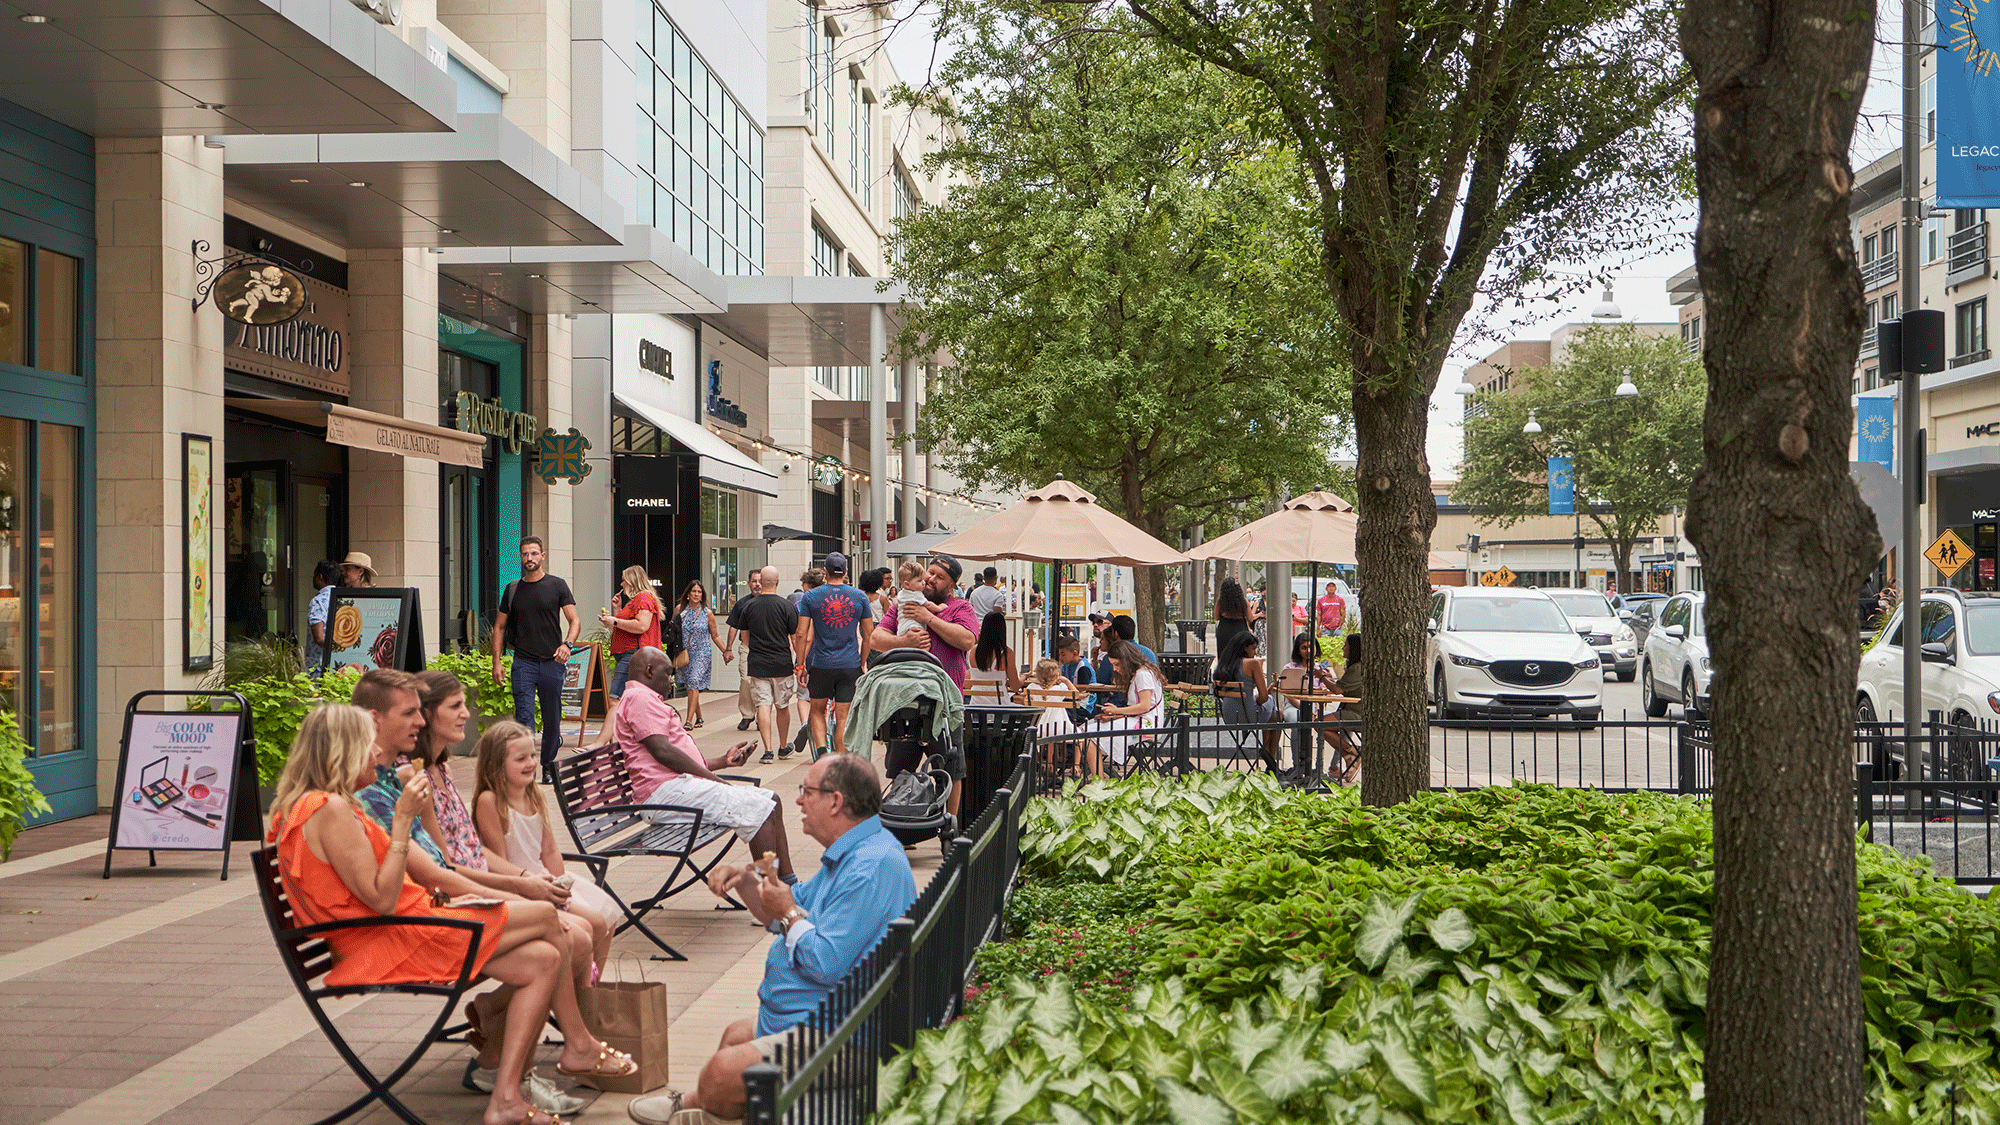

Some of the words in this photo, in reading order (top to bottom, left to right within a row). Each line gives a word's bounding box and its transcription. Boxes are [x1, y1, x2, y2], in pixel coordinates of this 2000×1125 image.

[1951, 145, 1999, 157] LEGAC
[1977, 164, 2000, 173] legacy
[376, 428, 401, 449] GELATO
[401, 435, 409, 450] AL
[409, 434, 440, 456] NATURALE
[627, 498, 671, 507] CHANEL
[155, 721, 172, 736] Big
[173, 722, 214, 733] COLOR
[168, 732, 206, 743] MOOD
[162, 833, 189, 842] credo
